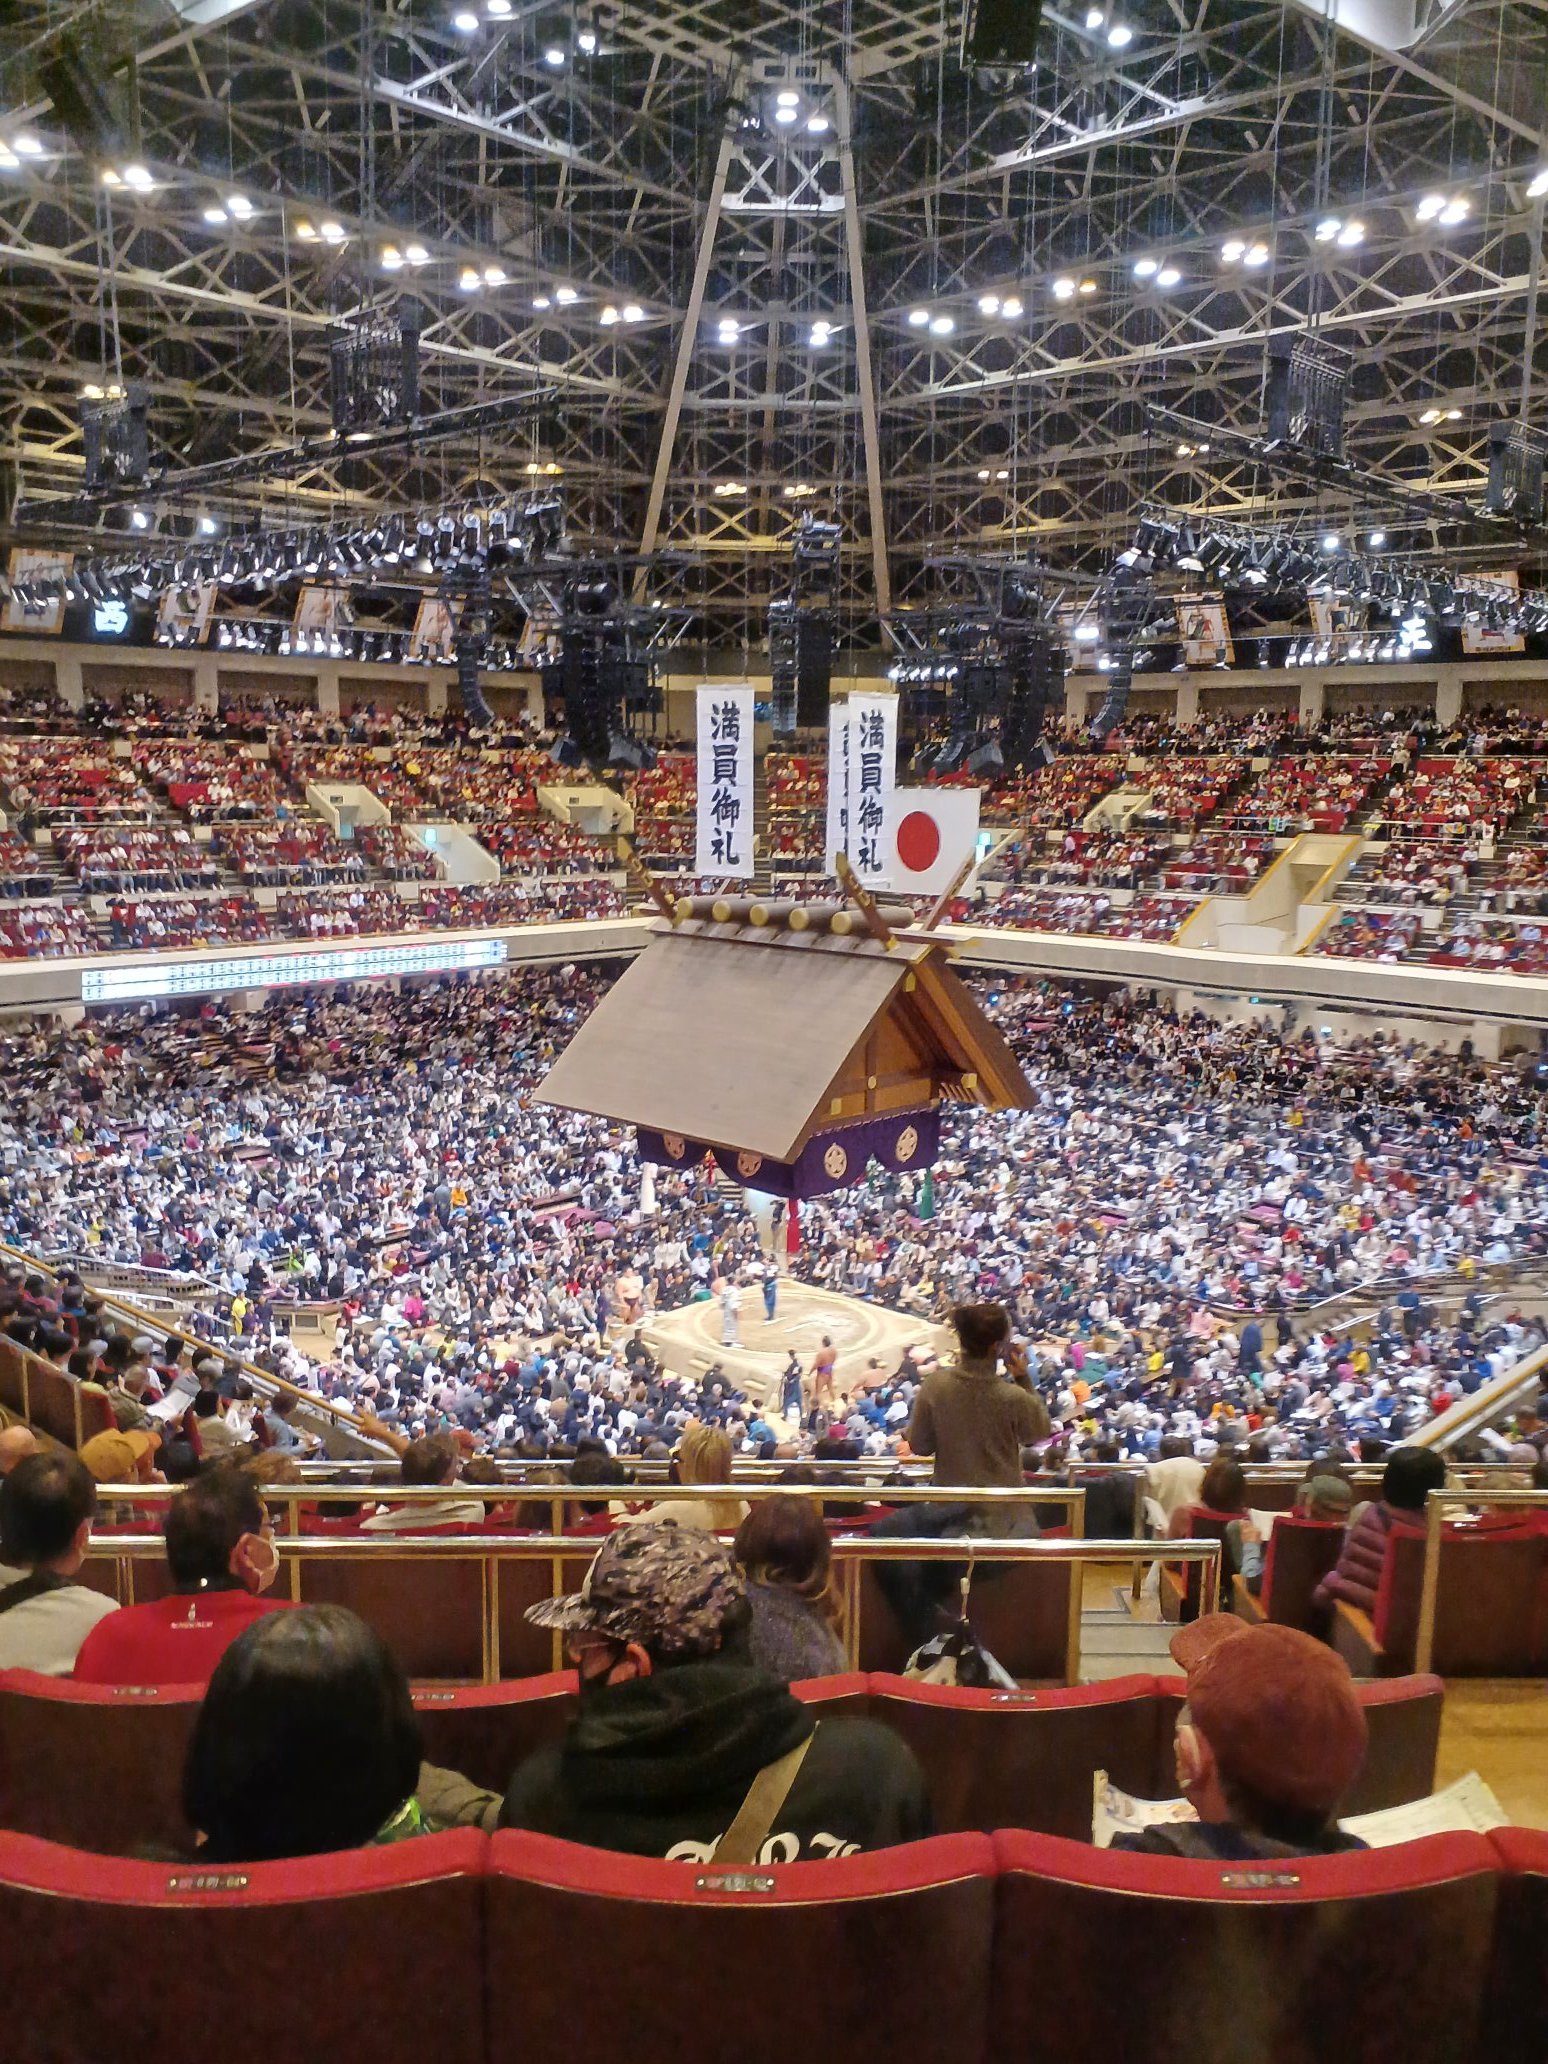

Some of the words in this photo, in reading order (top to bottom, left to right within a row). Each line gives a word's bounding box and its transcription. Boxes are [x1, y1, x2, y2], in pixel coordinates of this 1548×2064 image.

[709, 700, 741, 866] 満員御礼
[857, 708, 885, 874] 満員御礼
